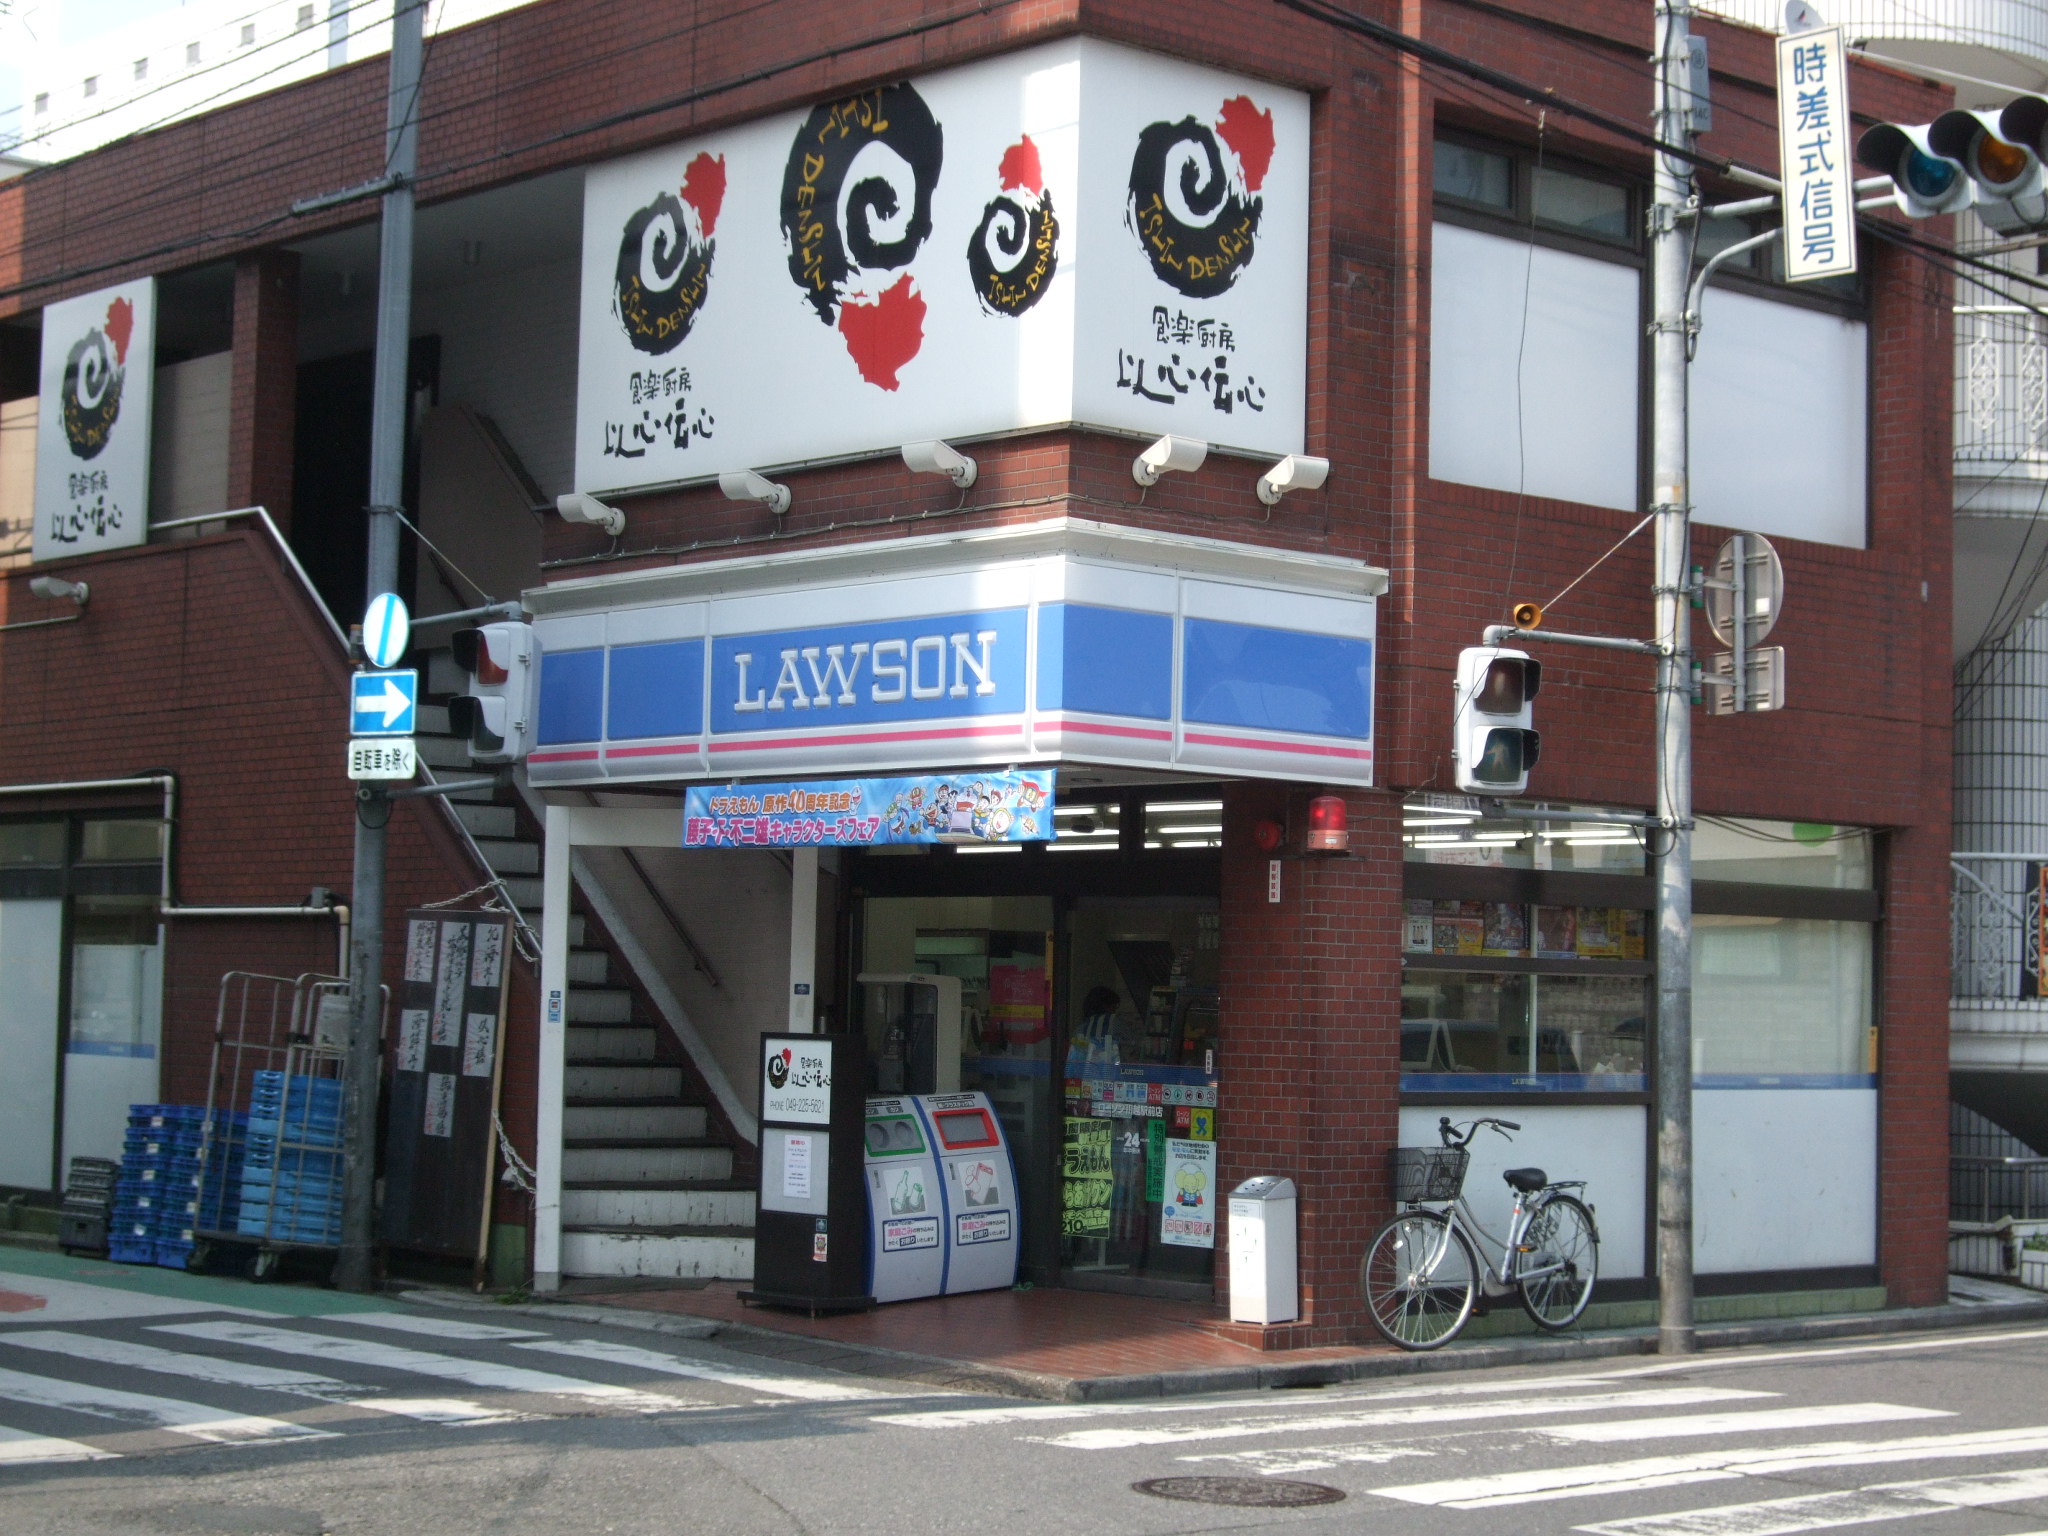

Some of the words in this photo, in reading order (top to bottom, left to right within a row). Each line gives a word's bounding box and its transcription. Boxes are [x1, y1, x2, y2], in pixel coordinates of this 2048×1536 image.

[1793, 42, 1836, 264] 時差式信号
[1153, 305, 1235, 352] 食楽厨房
[630, 367, 692, 404] 食楽厨房
[1117, 348, 1266, 414] 以心伝心
[603, 398, 715, 459] 以心伝心
[51, 495, 123, 542] 以心伝心
[734, 630, 998, 713] LAWSON
[710, 796, 760, 815] ドラえもん
[762, 789, 852, 814] 原作40周年記念
[791, 1070, 831, 1088] 以心伝心
[1124, 1132, 1140, 1148] 24
[1176, 1116, 1190, 1125] ATM
[1064, 1144, 1111, 1174] ラえもん
